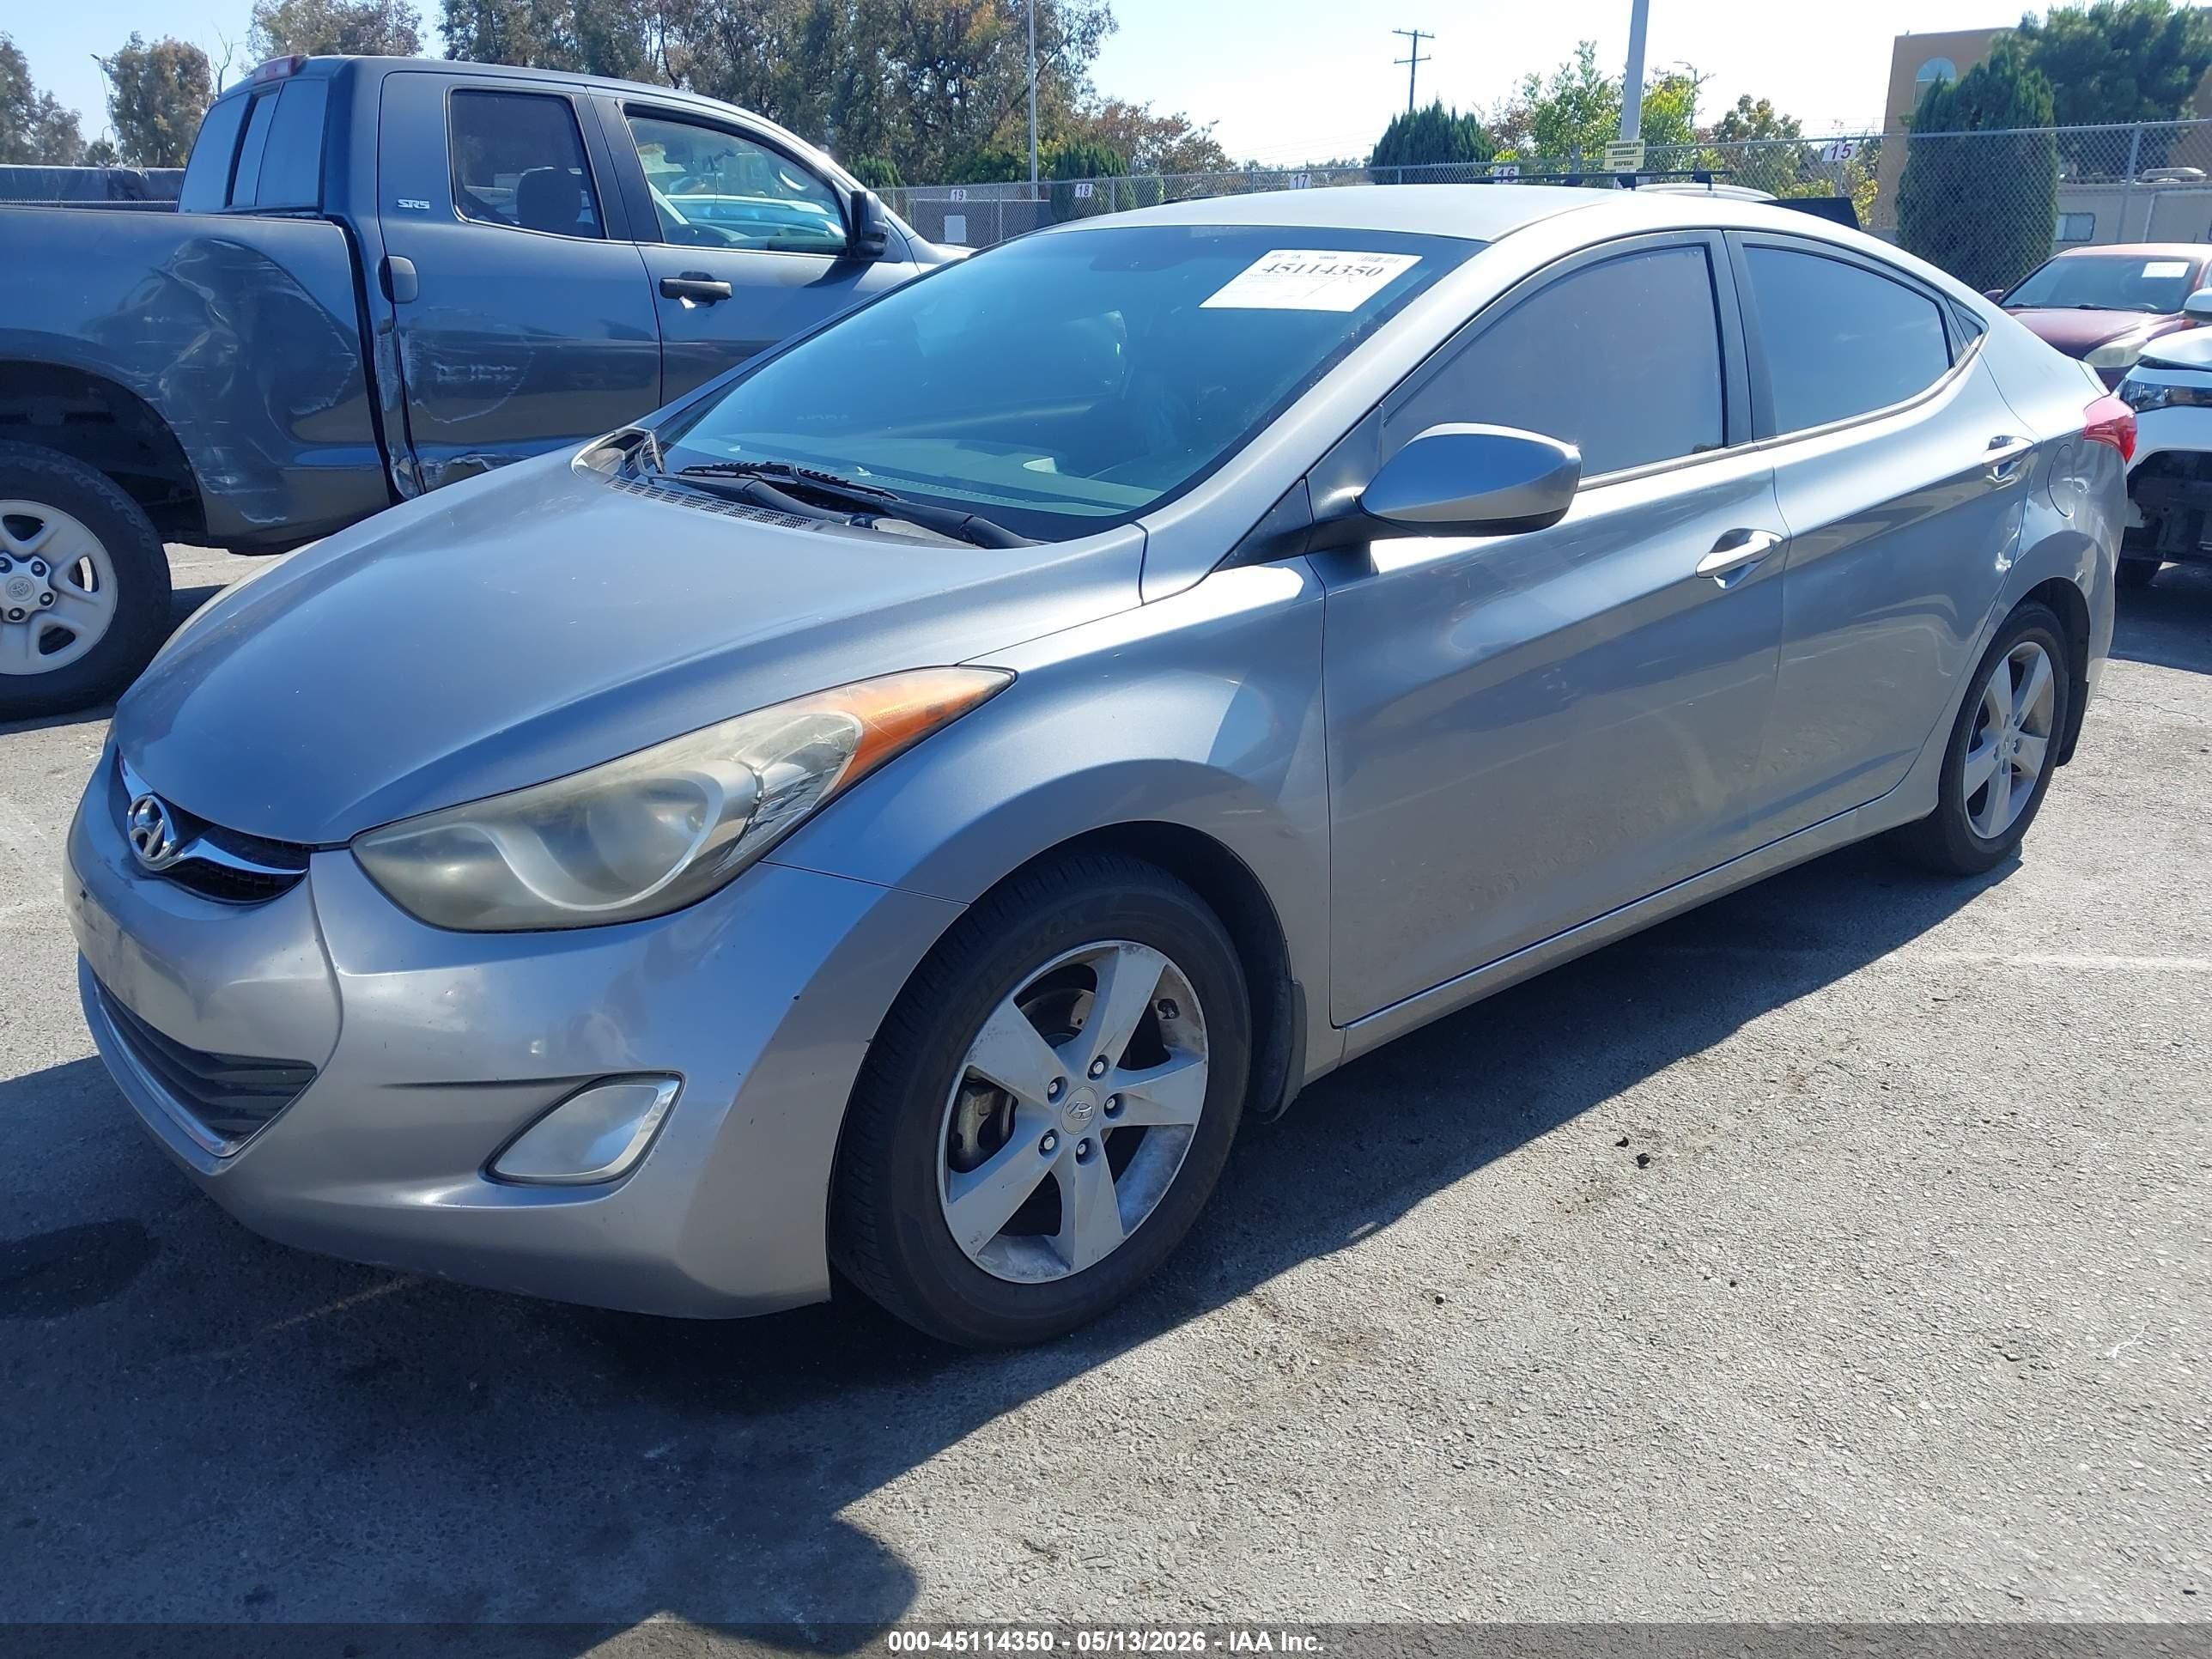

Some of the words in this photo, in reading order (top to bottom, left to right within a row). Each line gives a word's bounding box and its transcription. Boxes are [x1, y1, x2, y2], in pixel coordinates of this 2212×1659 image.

[1831, 143, 1853, 160] 15
[1293, 174, 1308, 189] 17
[1498, 167, 1516, 183] 16
[953, 190, 963, 200] 19
[1079, 185, 1090, 196] 18
[398, 198, 430, 210] SR5
[1262, 263, 1384, 276] 45114350
